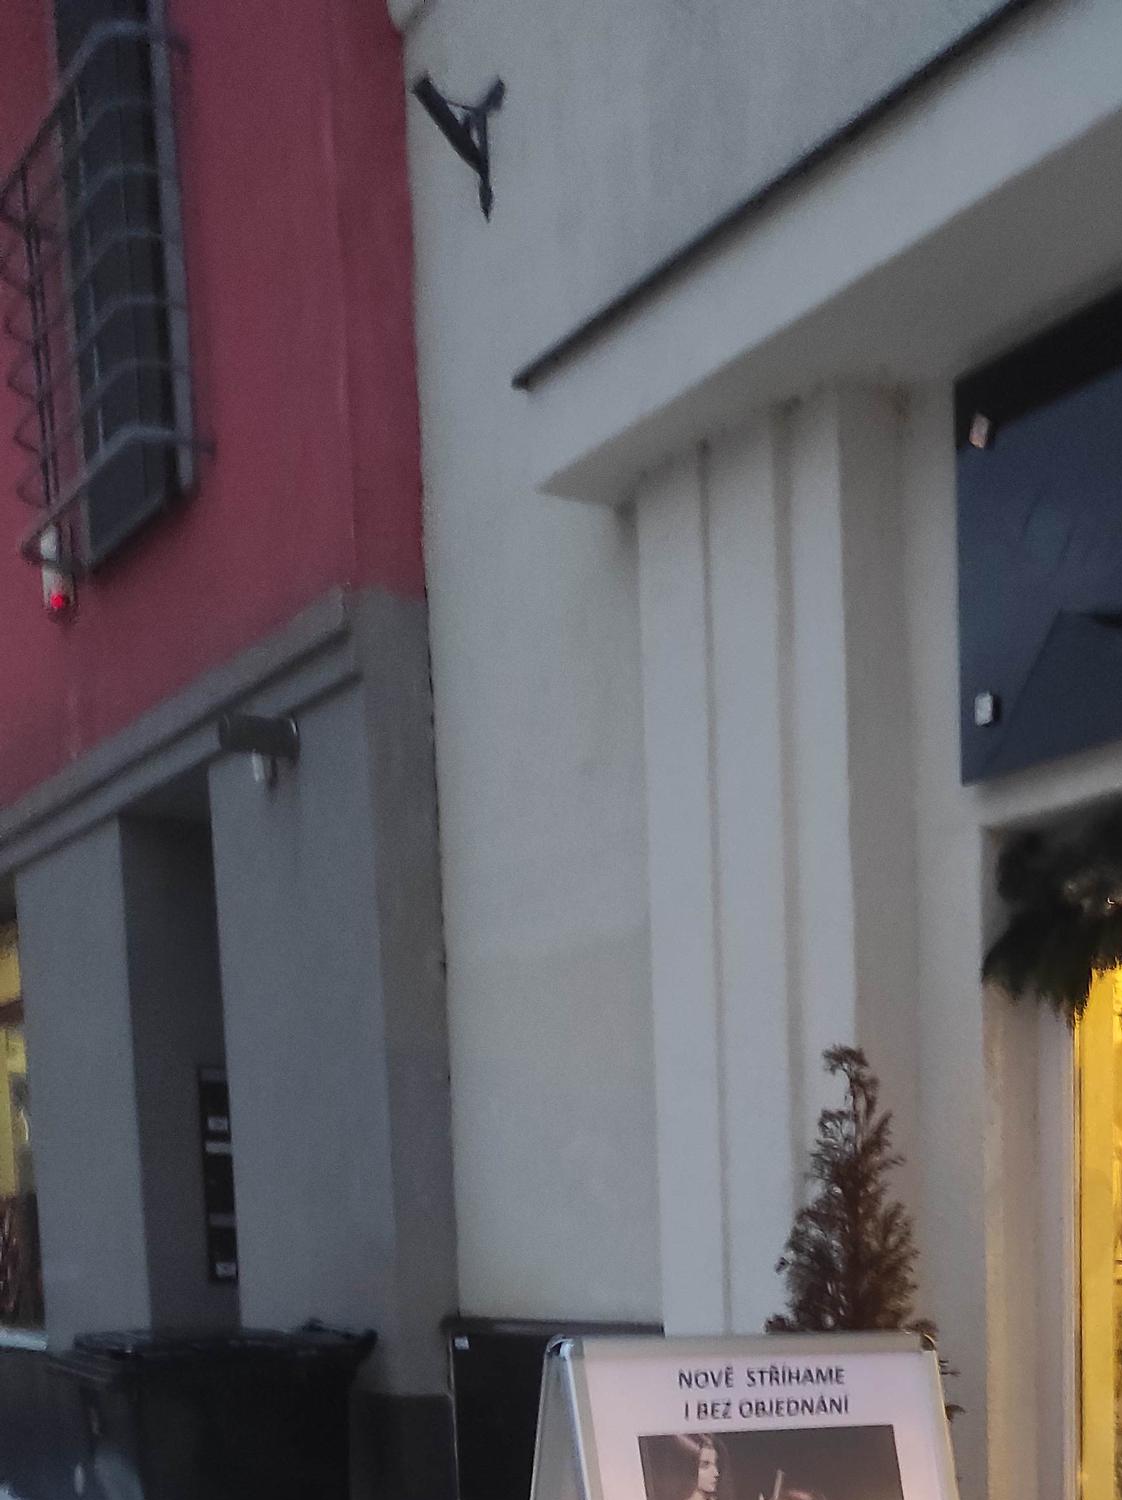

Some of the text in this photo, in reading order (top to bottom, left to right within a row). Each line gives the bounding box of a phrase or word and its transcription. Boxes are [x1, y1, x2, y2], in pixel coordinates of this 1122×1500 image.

[683, 1394, 850, 1421] I BEZ OBJEDNÁNÍ
